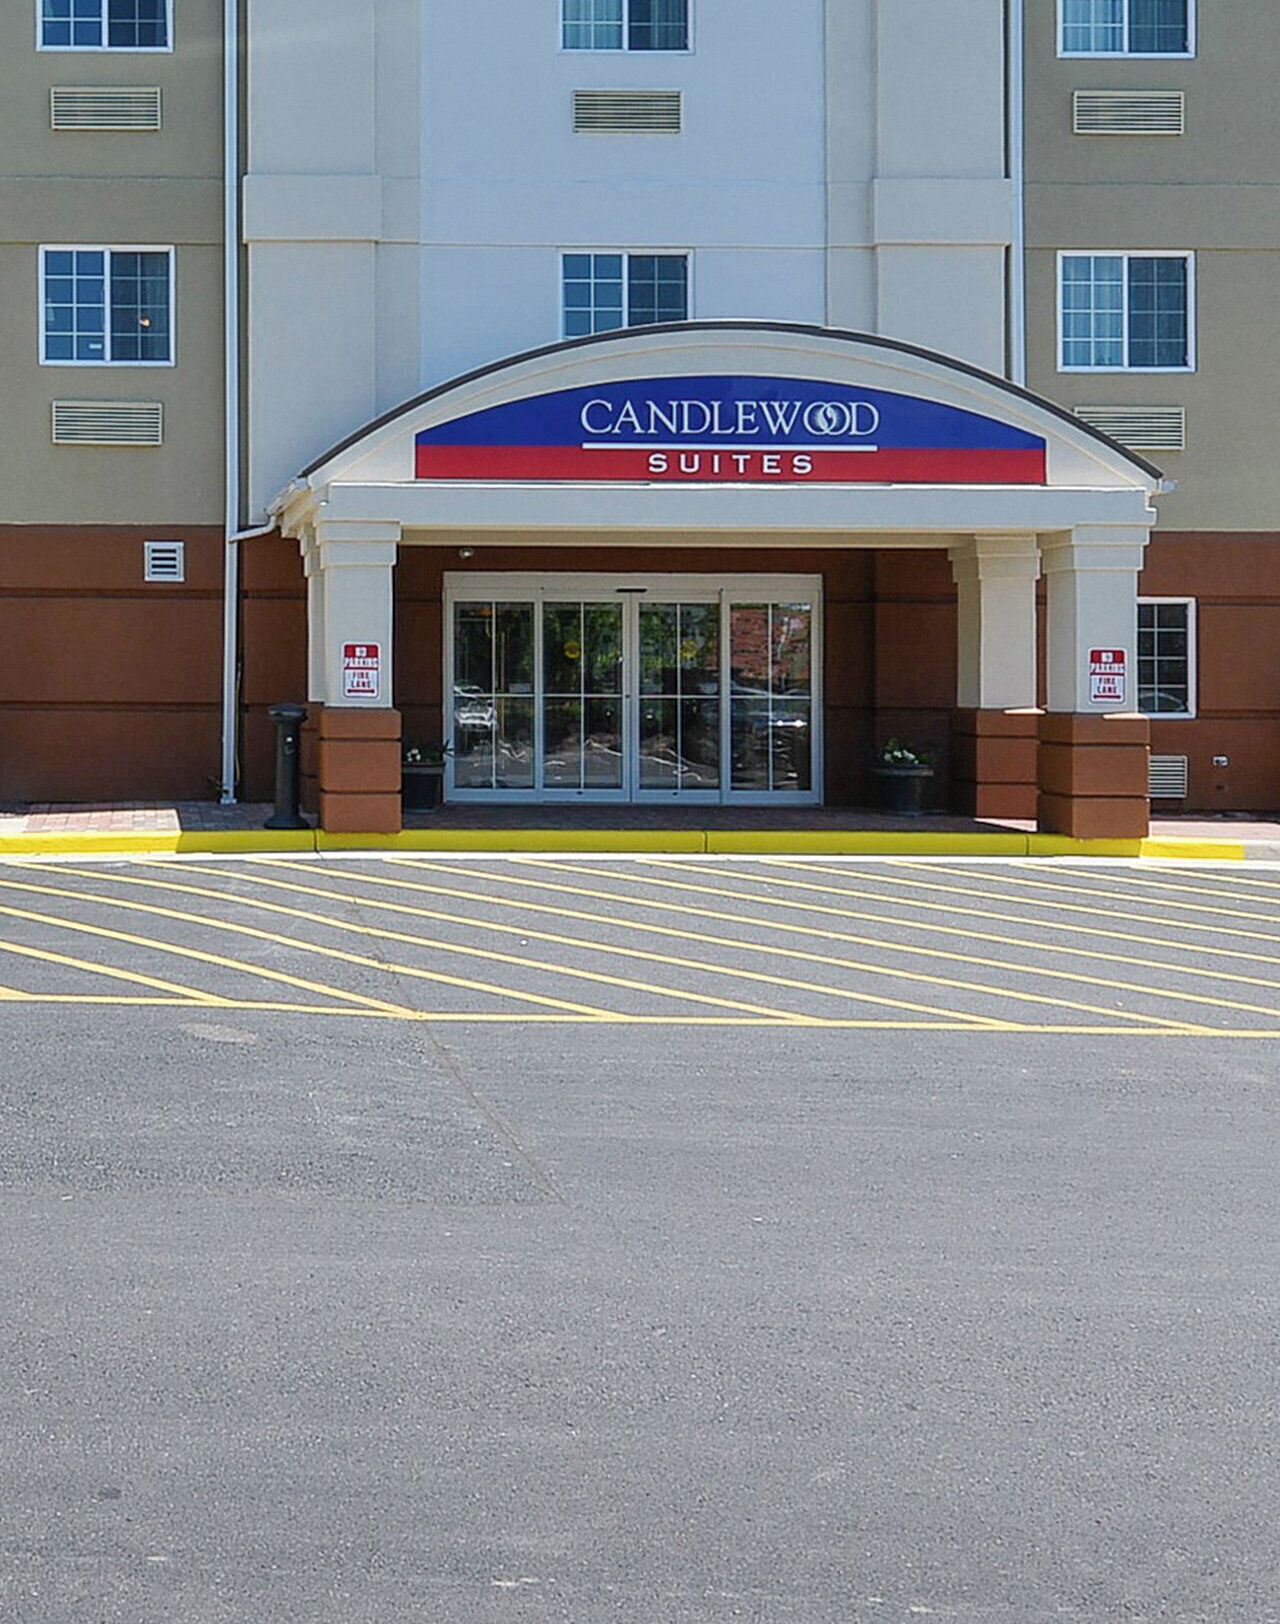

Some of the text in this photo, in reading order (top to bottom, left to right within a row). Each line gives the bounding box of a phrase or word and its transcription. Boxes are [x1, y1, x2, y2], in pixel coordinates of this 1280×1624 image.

[581, 398, 880, 436] CANDLEWOOD
[648, 453, 813, 474] SUITES
[352, 671, 370, 679] FIRE
[351, 680, 371, 688] LANE
